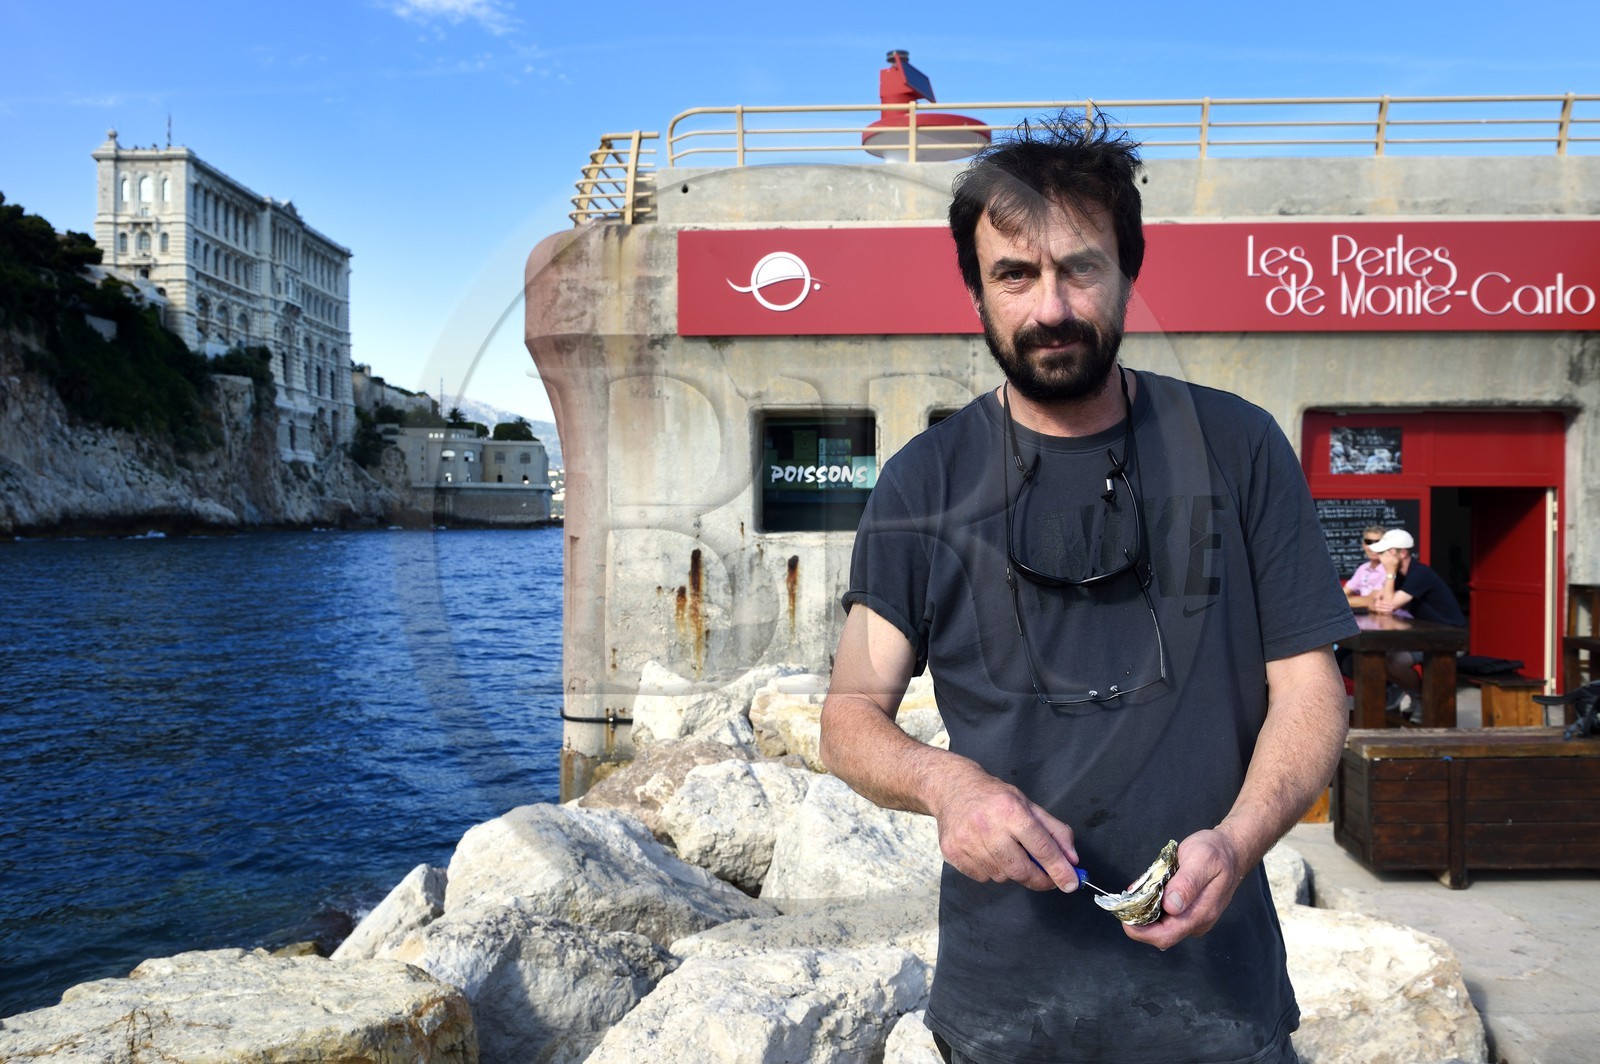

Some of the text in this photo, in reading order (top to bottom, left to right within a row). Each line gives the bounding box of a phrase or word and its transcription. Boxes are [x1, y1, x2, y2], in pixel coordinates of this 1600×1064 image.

[1247, 233, 1458, 291] Les Perles
[1265, 271, 1597, 319] de Monte-Carlo
[770, 465, 868, 484] POISSONS
